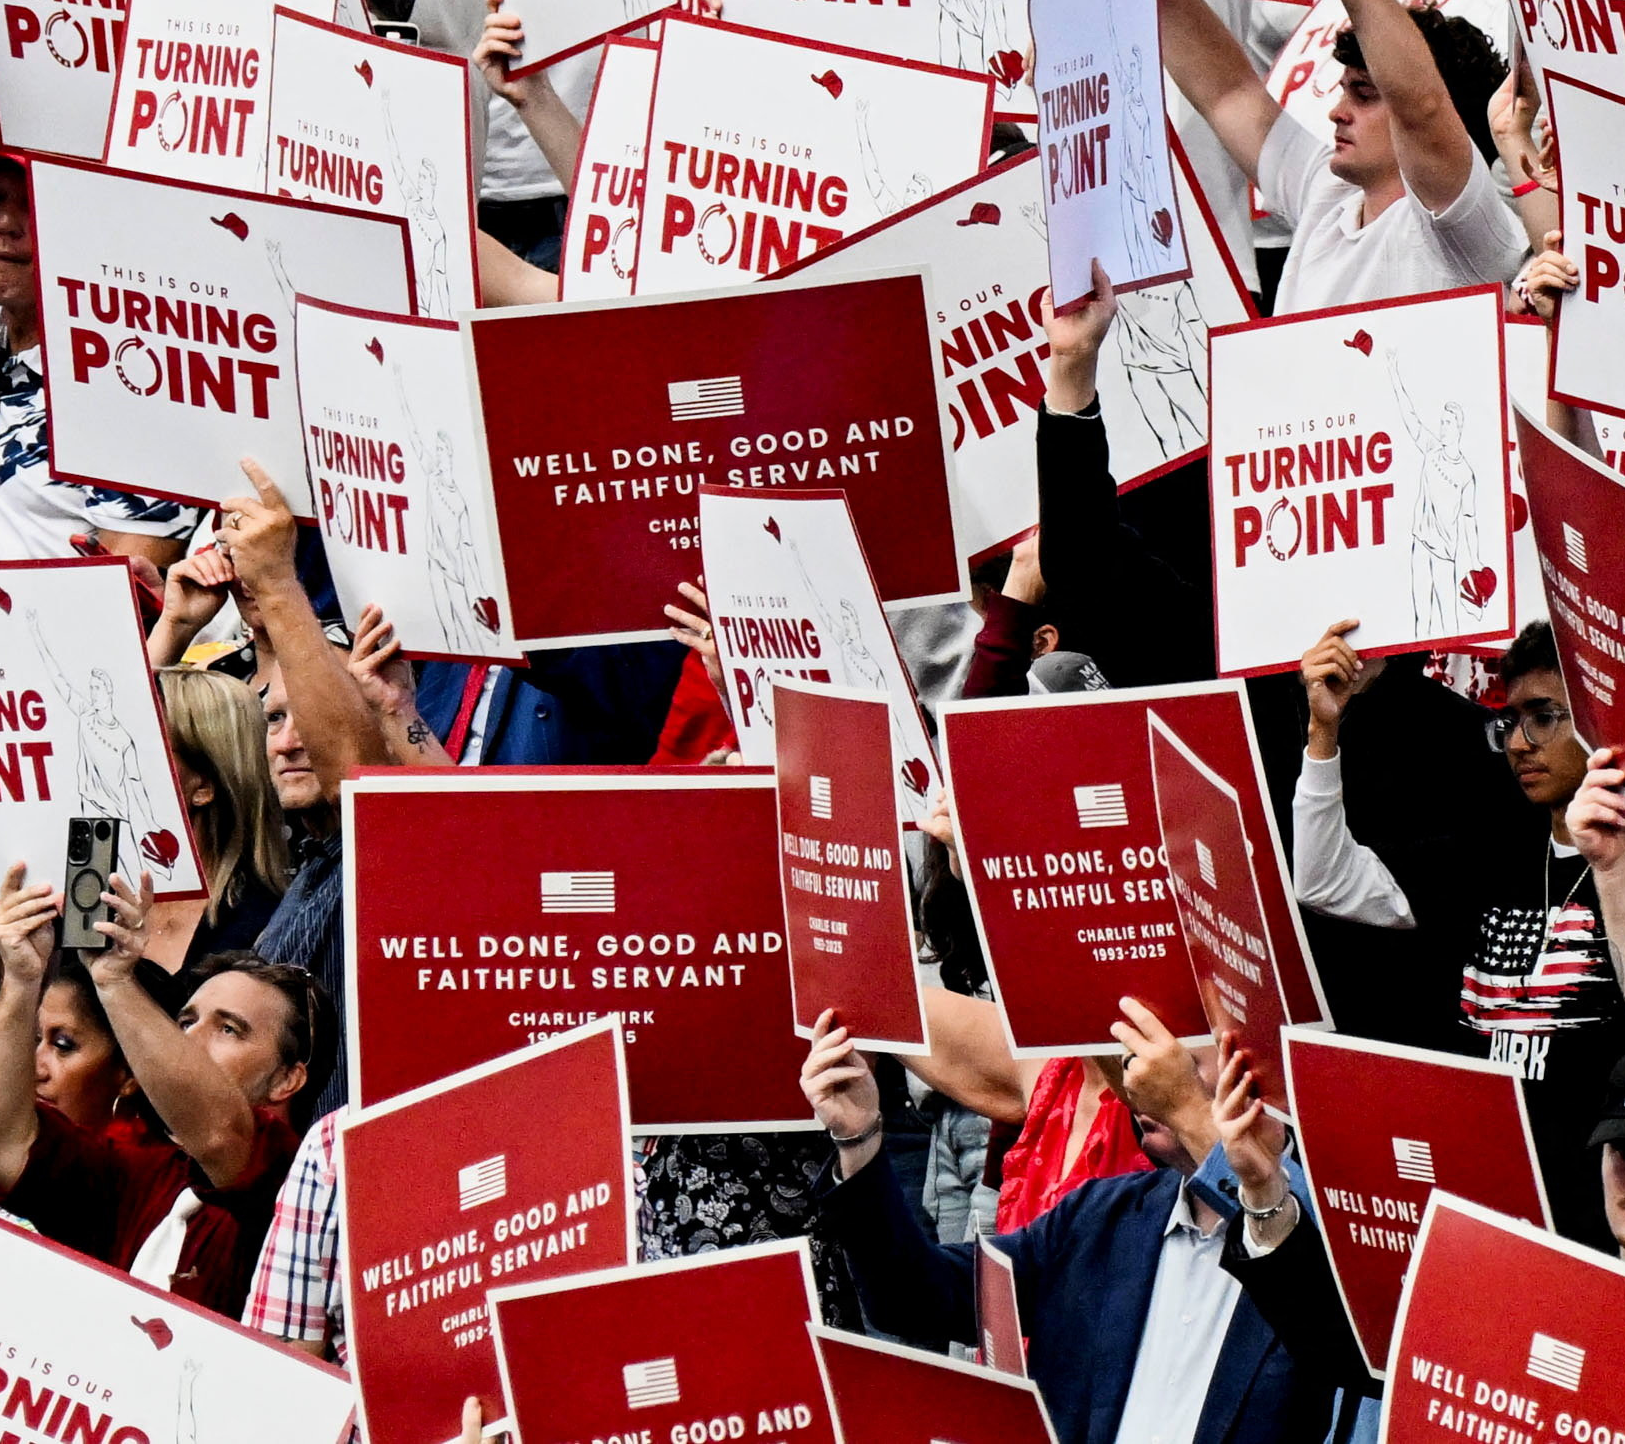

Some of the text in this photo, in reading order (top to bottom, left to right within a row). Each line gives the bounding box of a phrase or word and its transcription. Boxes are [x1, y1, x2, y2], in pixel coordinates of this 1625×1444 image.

[380, 932, 783, 962] WELL DONE, GOOD AND
[418, 964, 746, 991] FAITHFUL SERVANT
[508, 1012, 598, 1027] CHARLIE
[1490, 1030, 1550, 1081] KIRK
